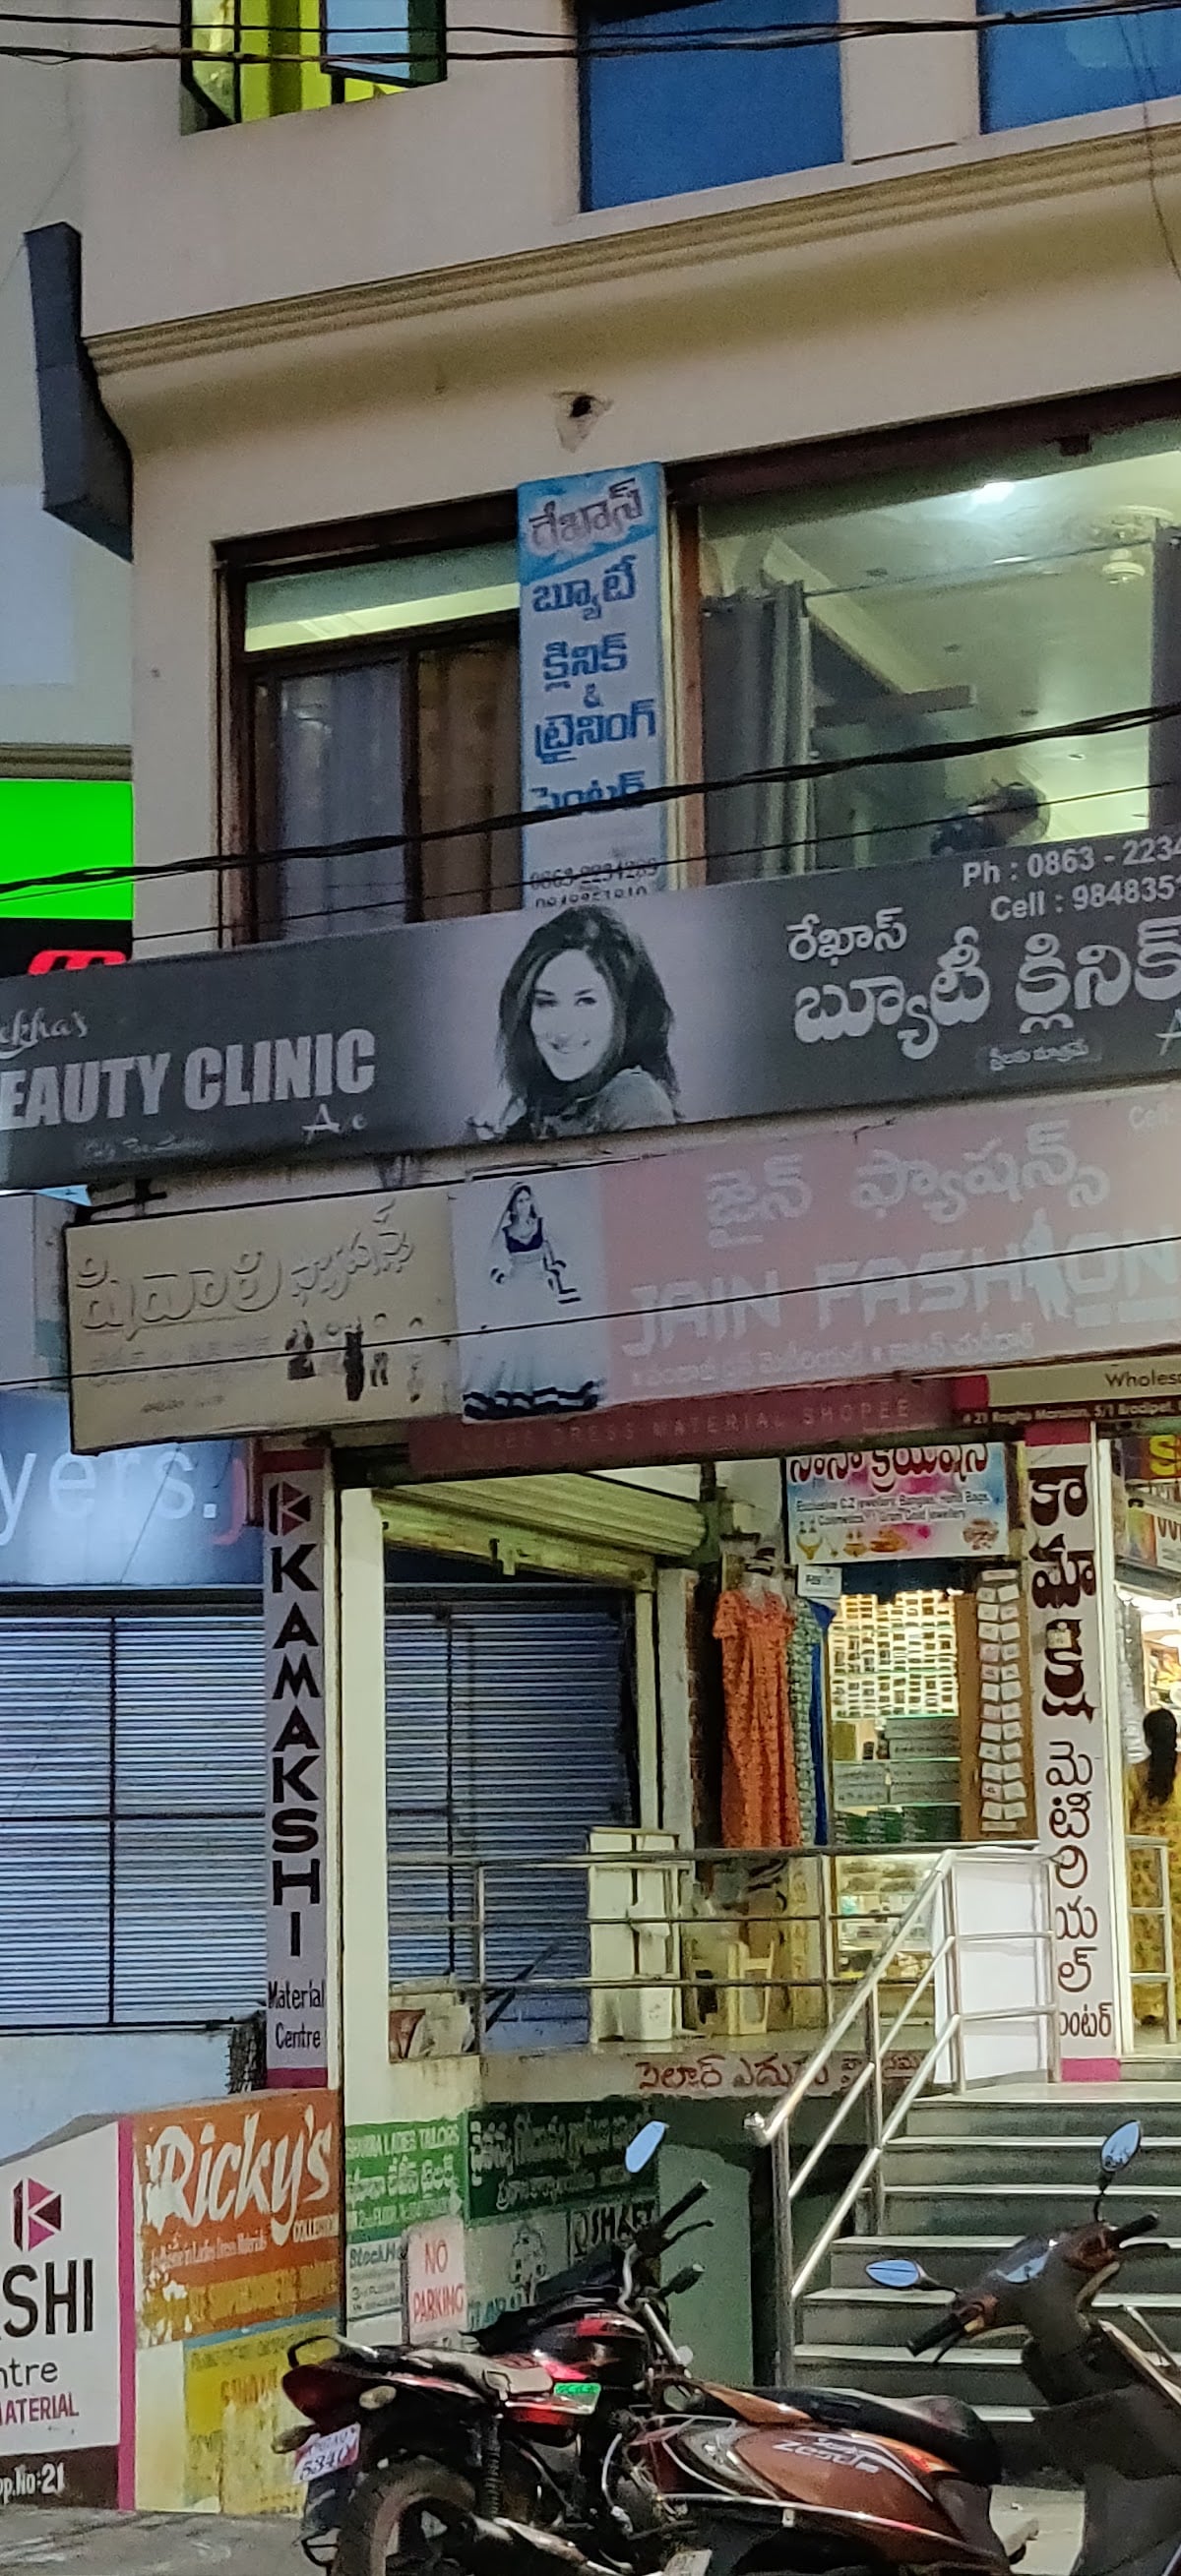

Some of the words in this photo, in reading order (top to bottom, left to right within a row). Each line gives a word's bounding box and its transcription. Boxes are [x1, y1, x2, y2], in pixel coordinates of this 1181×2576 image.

[542, 632, 628, 692] క్లినిక్
[585, 684, 603, 707] &
[963, 860, 1001, 887] Ph
[1026, 845, 1095, 879] 0863
[990, 889, 1045, 921] Cell
[787, 907, 907, 966] రేఖాస్
[794, 926, 990, 1060] బ్యూటీ
[184, 1028, 375, 1112] CLINIC
[622, 1269, 780, 1359] JAIN
[653, 1410, 787, 1440] MATERIAL
[802, 1398, 910, 1425] SHOPEE
[271, 1543, 321, 1958] KAMAKSHI
[268, 1979, 326, 2009] Material
[276, 2021, 321, 2050] Centre
[147, 2104, 333, 2247] Ricky's
[424, 2242, 448, 2275] NO
[0, 2259, 93, 2340] SHI
[413, 2284, 465, 2323] PARKING
